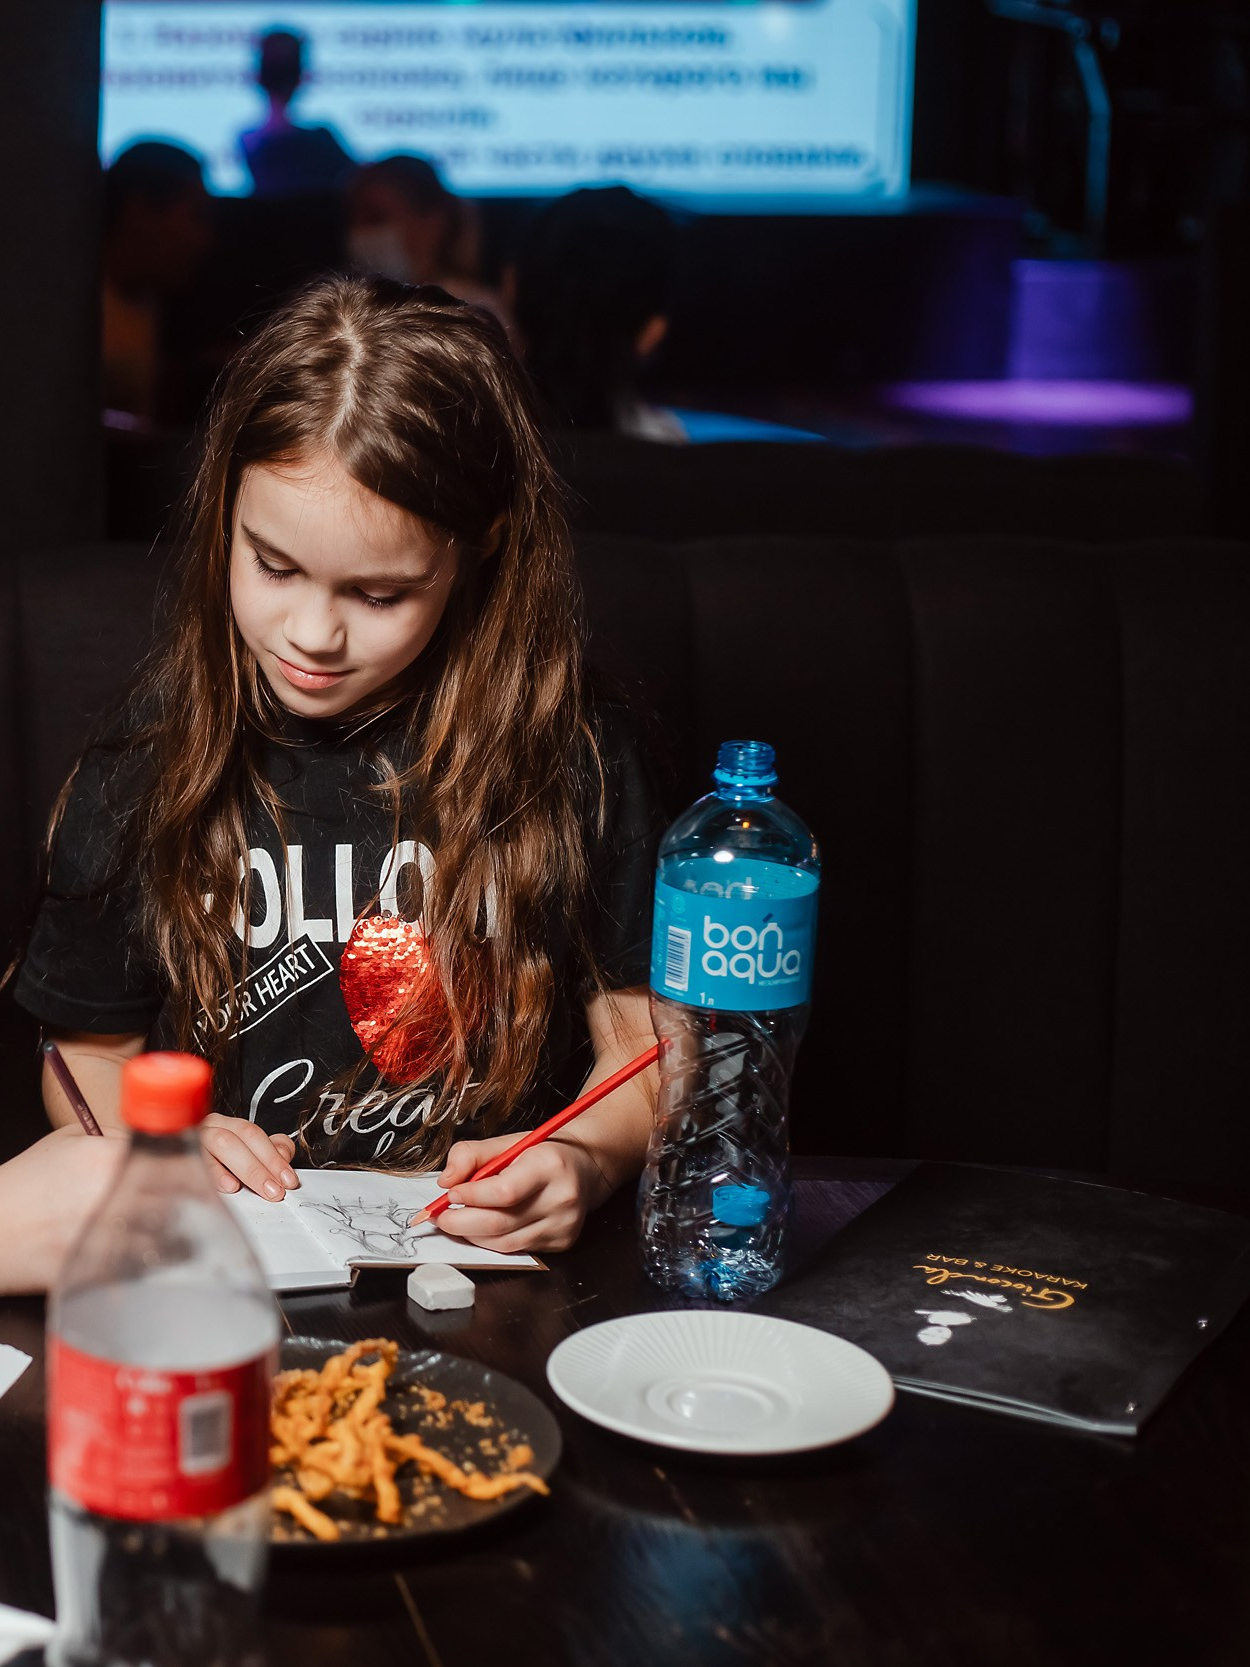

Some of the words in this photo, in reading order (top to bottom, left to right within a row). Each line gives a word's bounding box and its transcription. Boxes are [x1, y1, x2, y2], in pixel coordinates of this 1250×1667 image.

[254, 942, 317, 1007] HEART
[701, 949, 801, 985] aqua
[925, 1252, 970, 1267] BAR
[973, 1260, 988, 1269] &
[913, 1264, 1076, 1311] Gioconda
[989, 1263, 1089, 1290] KARAOKE
